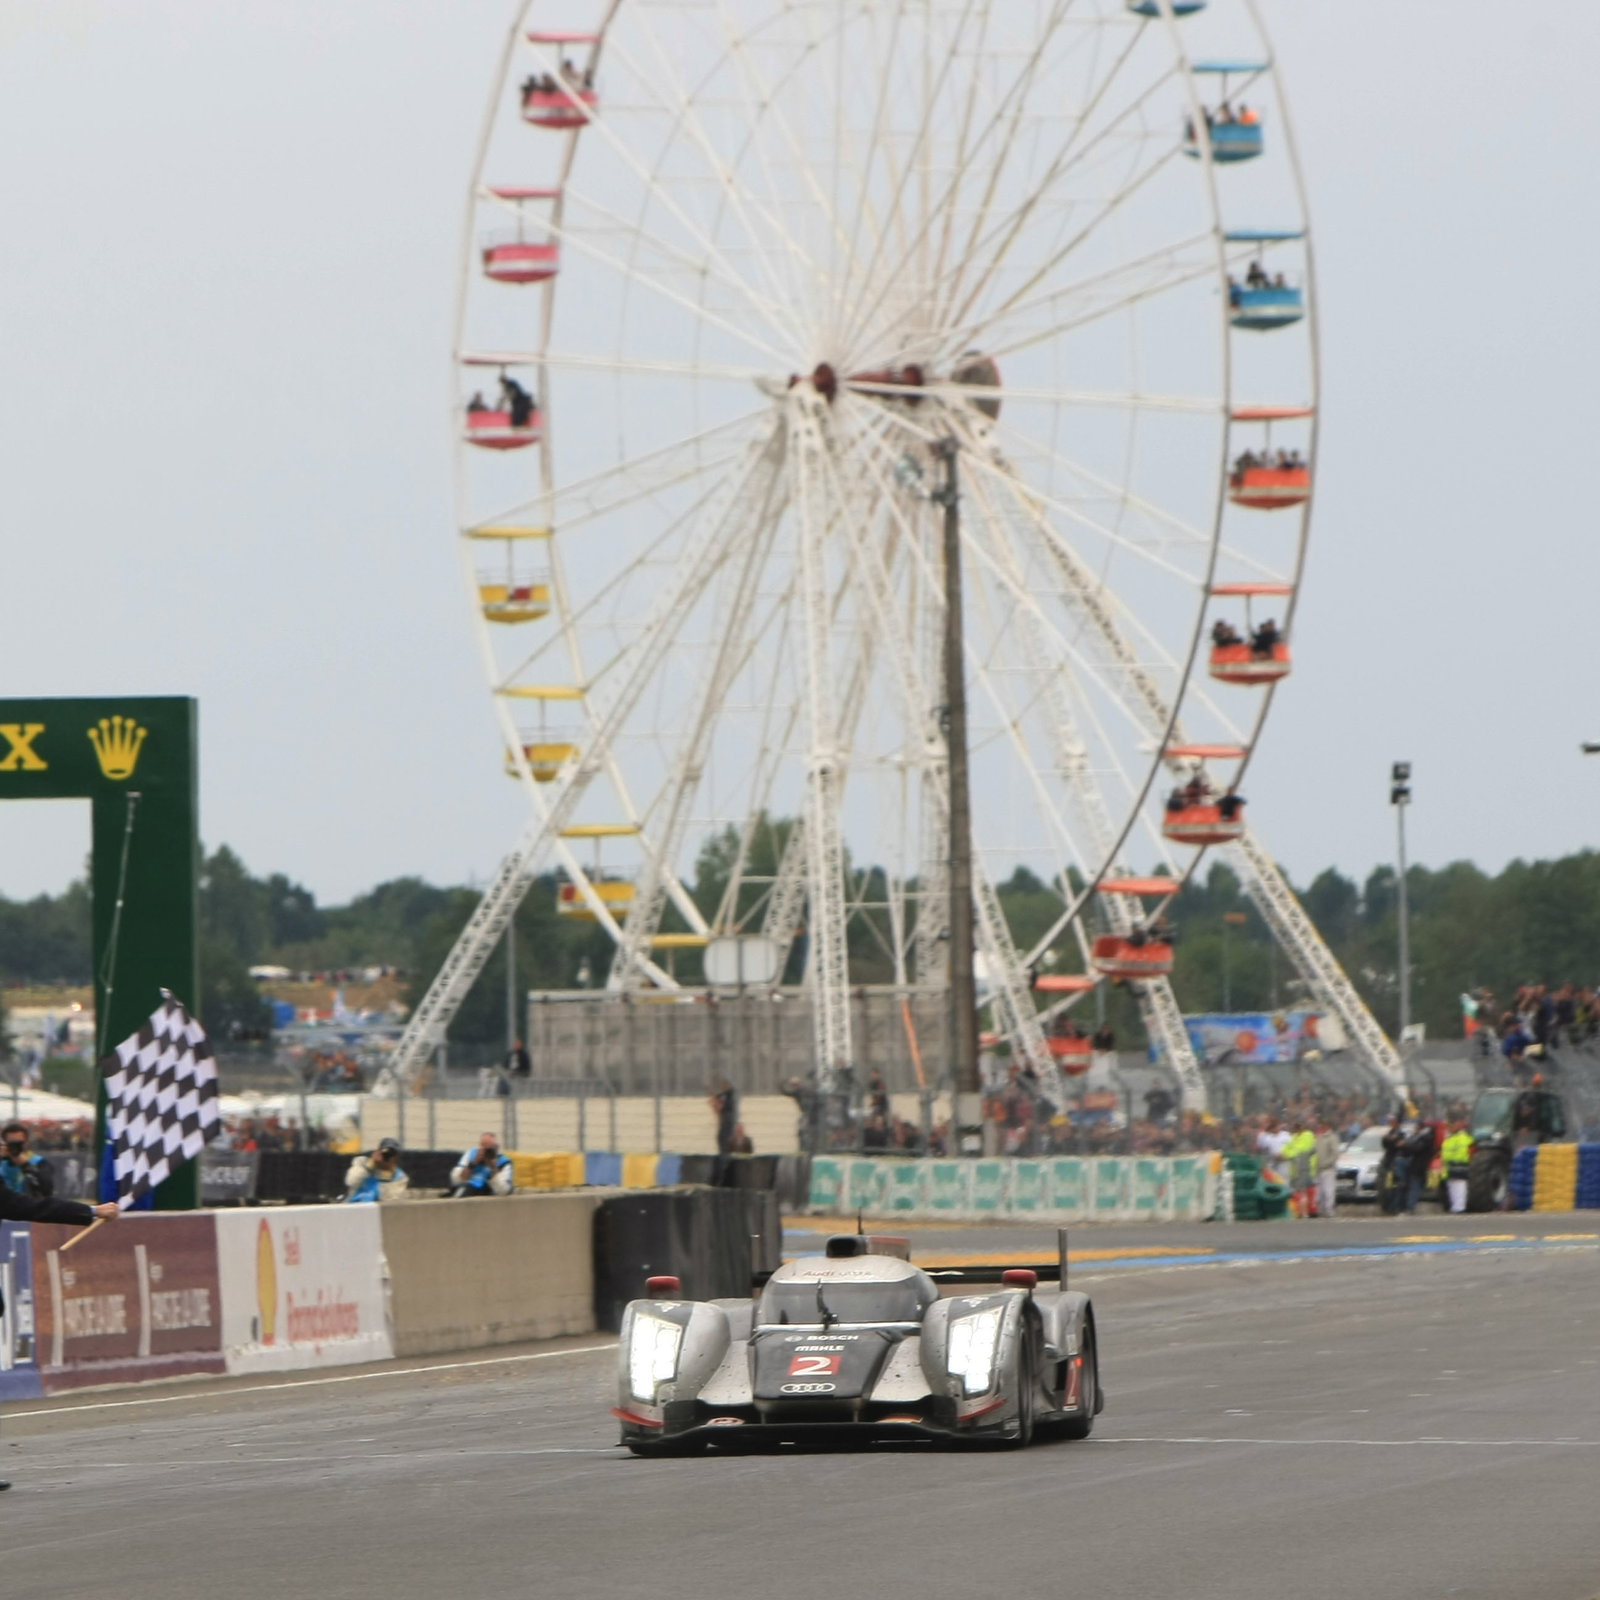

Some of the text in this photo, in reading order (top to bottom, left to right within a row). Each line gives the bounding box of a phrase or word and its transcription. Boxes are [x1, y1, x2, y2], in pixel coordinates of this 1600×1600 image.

[0, 723, 47, 771] X
[806, 1334, 859, 1342] BOSCH
[791, 1356, 833, 1376] 2
